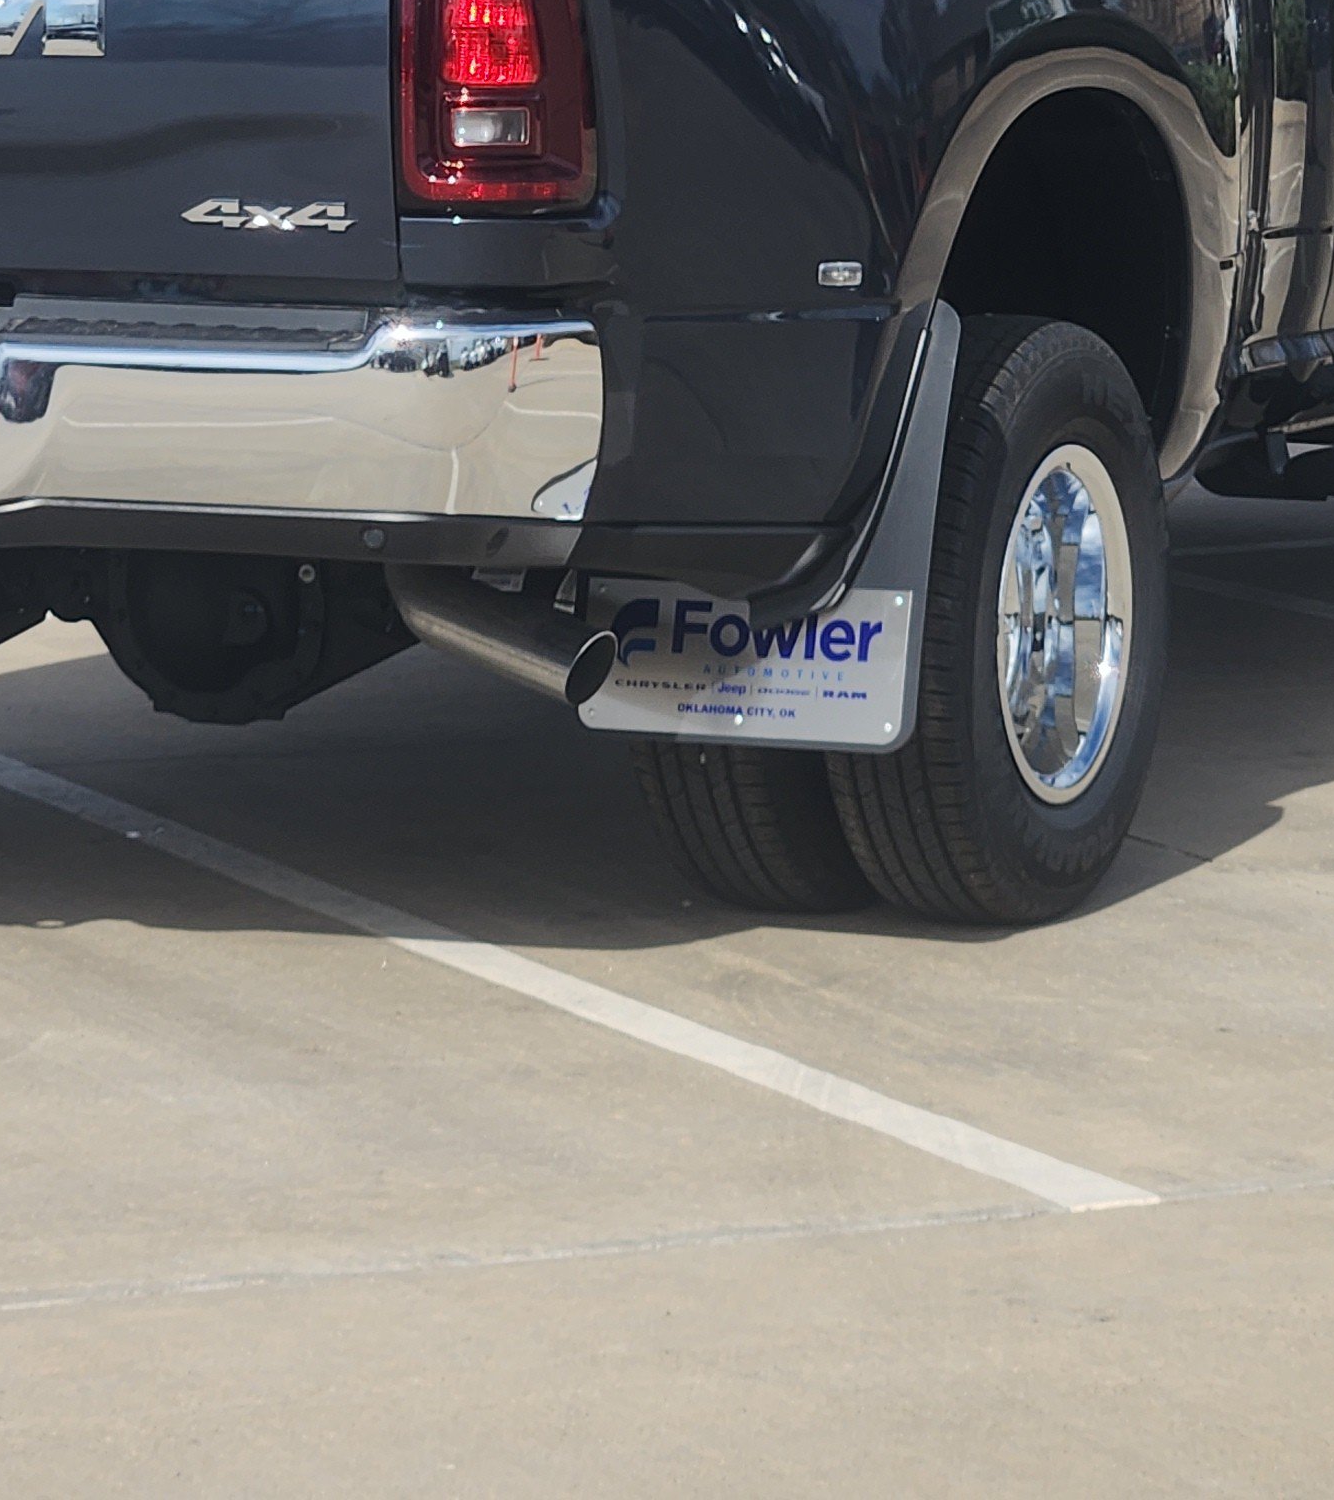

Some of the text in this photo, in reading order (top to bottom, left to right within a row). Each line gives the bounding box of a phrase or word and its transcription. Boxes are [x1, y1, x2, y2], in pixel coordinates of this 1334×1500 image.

[671, 599, 883, 663] Fowler
[703, 665, 845, 682] AUTOMOTIVE
[614, 678, 707, 691] CHRYSLER
[717, 682, 747, 696] Jeep
[822, 689, 867, 700] RAM
[677, 702, 796, 719] OKLAHOMA CITY, OK
